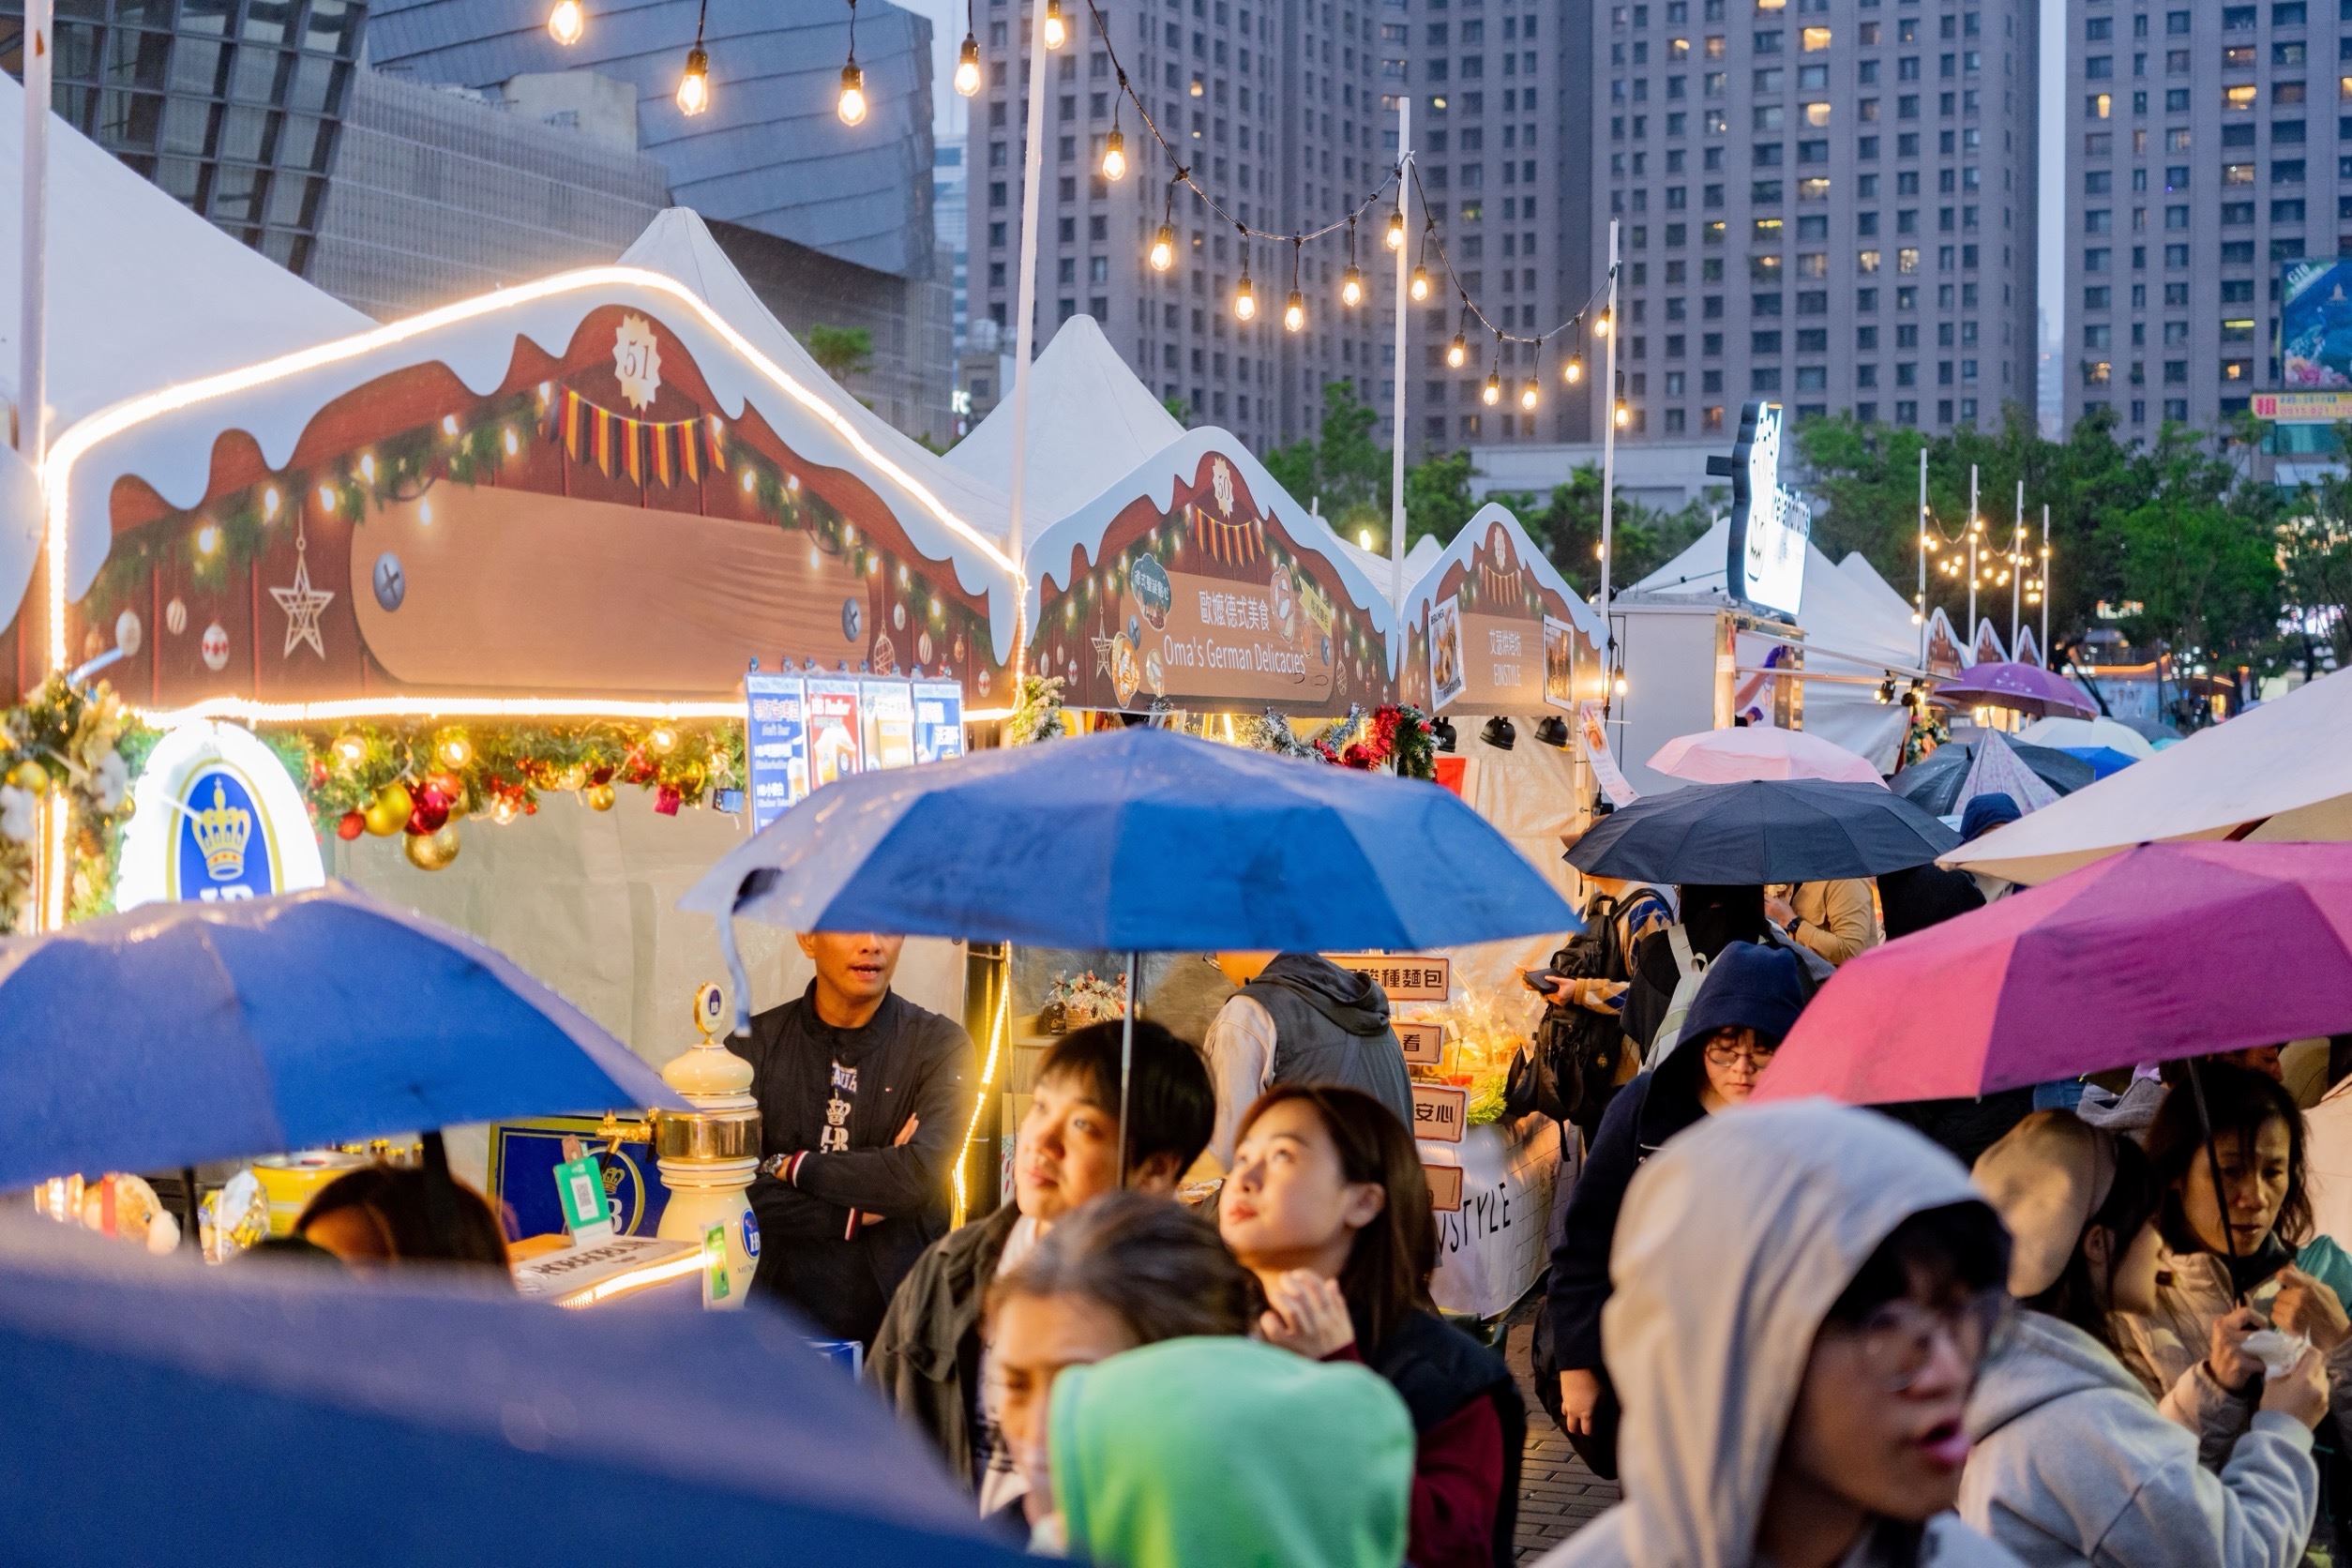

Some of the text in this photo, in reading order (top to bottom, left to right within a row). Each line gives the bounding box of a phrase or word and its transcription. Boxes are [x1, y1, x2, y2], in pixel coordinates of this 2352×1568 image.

[624, 339, 649, 380] 51
[1217, 475, 1230, 501] 50
[1163, 634, 1305, 674] Oma's German Delicacies
[1347, 969, 1442, 988] 種麵包
